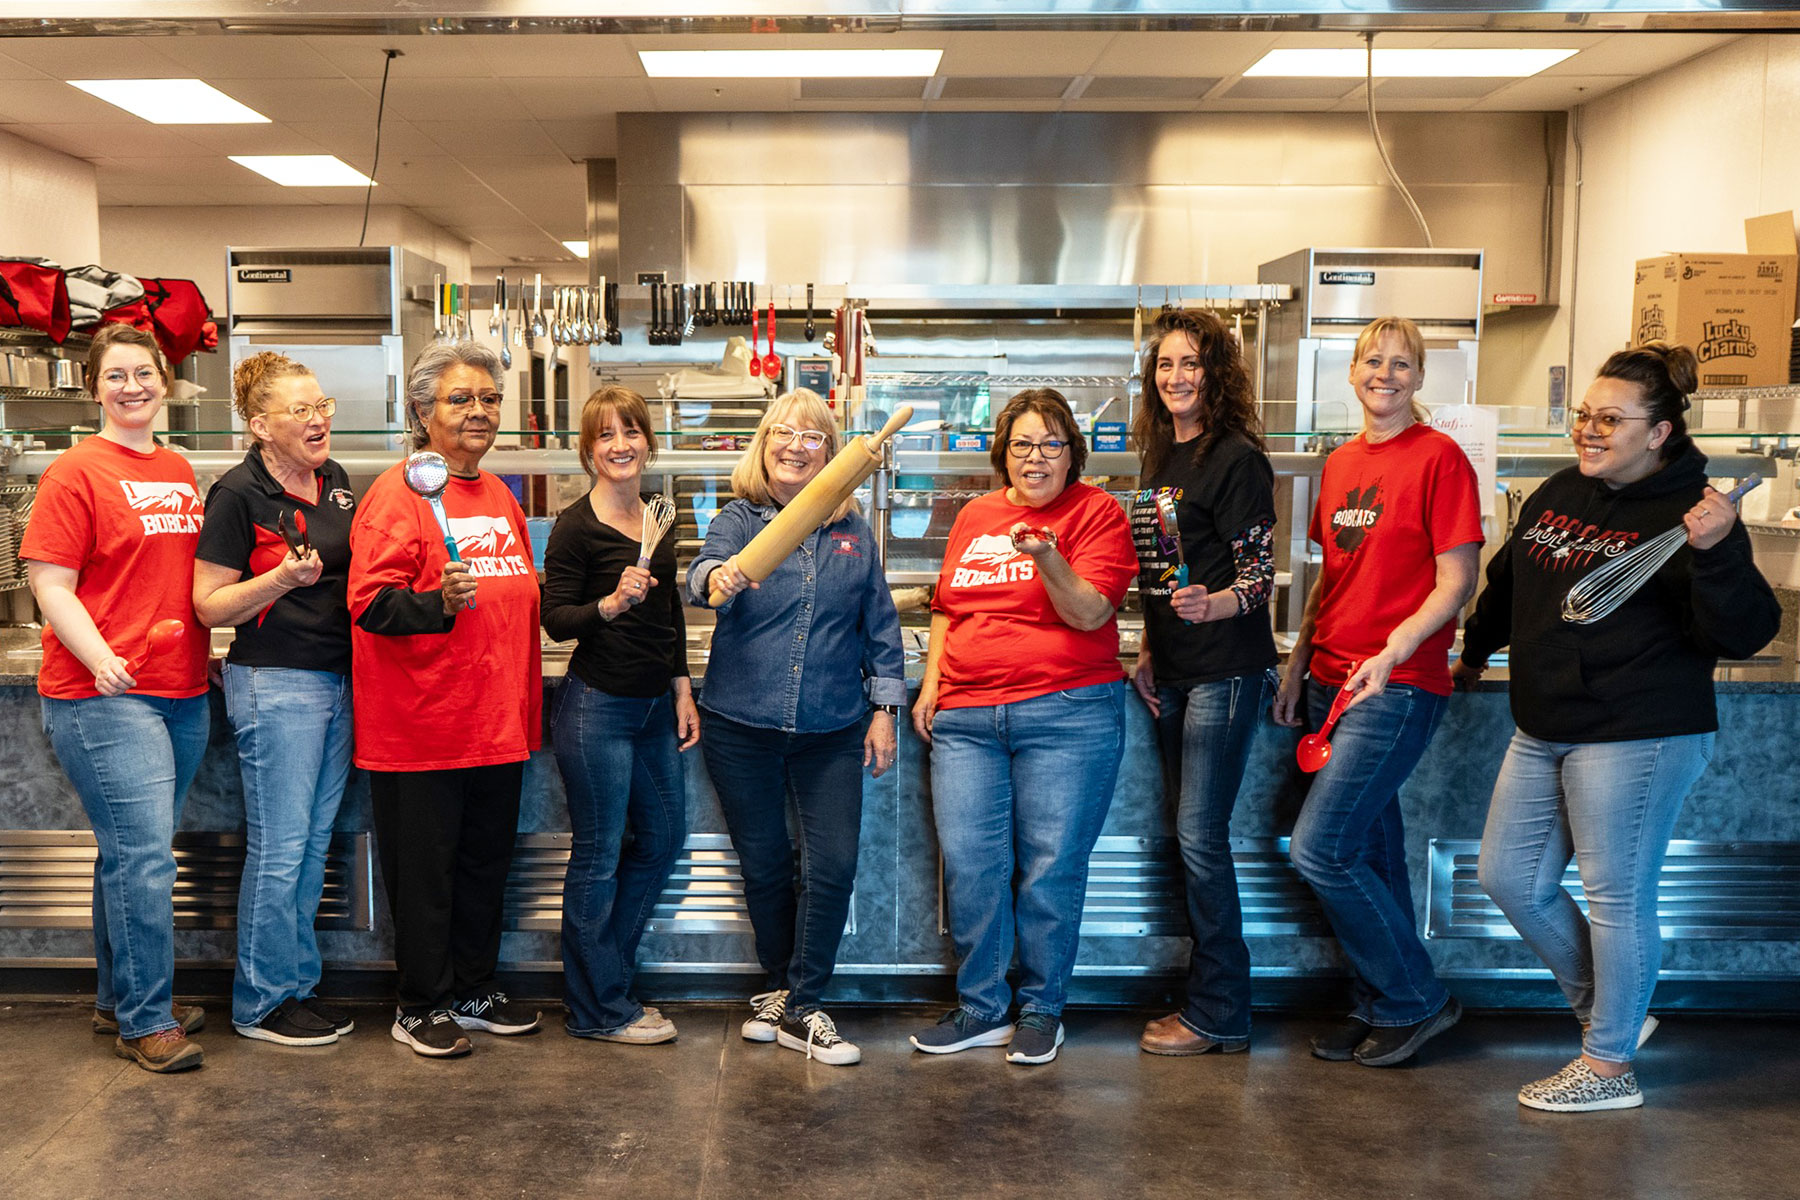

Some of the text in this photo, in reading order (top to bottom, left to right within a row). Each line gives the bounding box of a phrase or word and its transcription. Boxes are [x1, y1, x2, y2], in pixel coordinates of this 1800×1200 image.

[240, 270, 288, 280] Continental
[1703, 319, 1751, 342] Lucky
[1697, 338, 1757, 364] Charms
[139, 513, 205, 536] BOBCAT
[1333, 508, 1377, 527] BOBCATS
[461, 555, 529, 578] OBCATS
[950, 560, 1034, 588] BOBCATS
